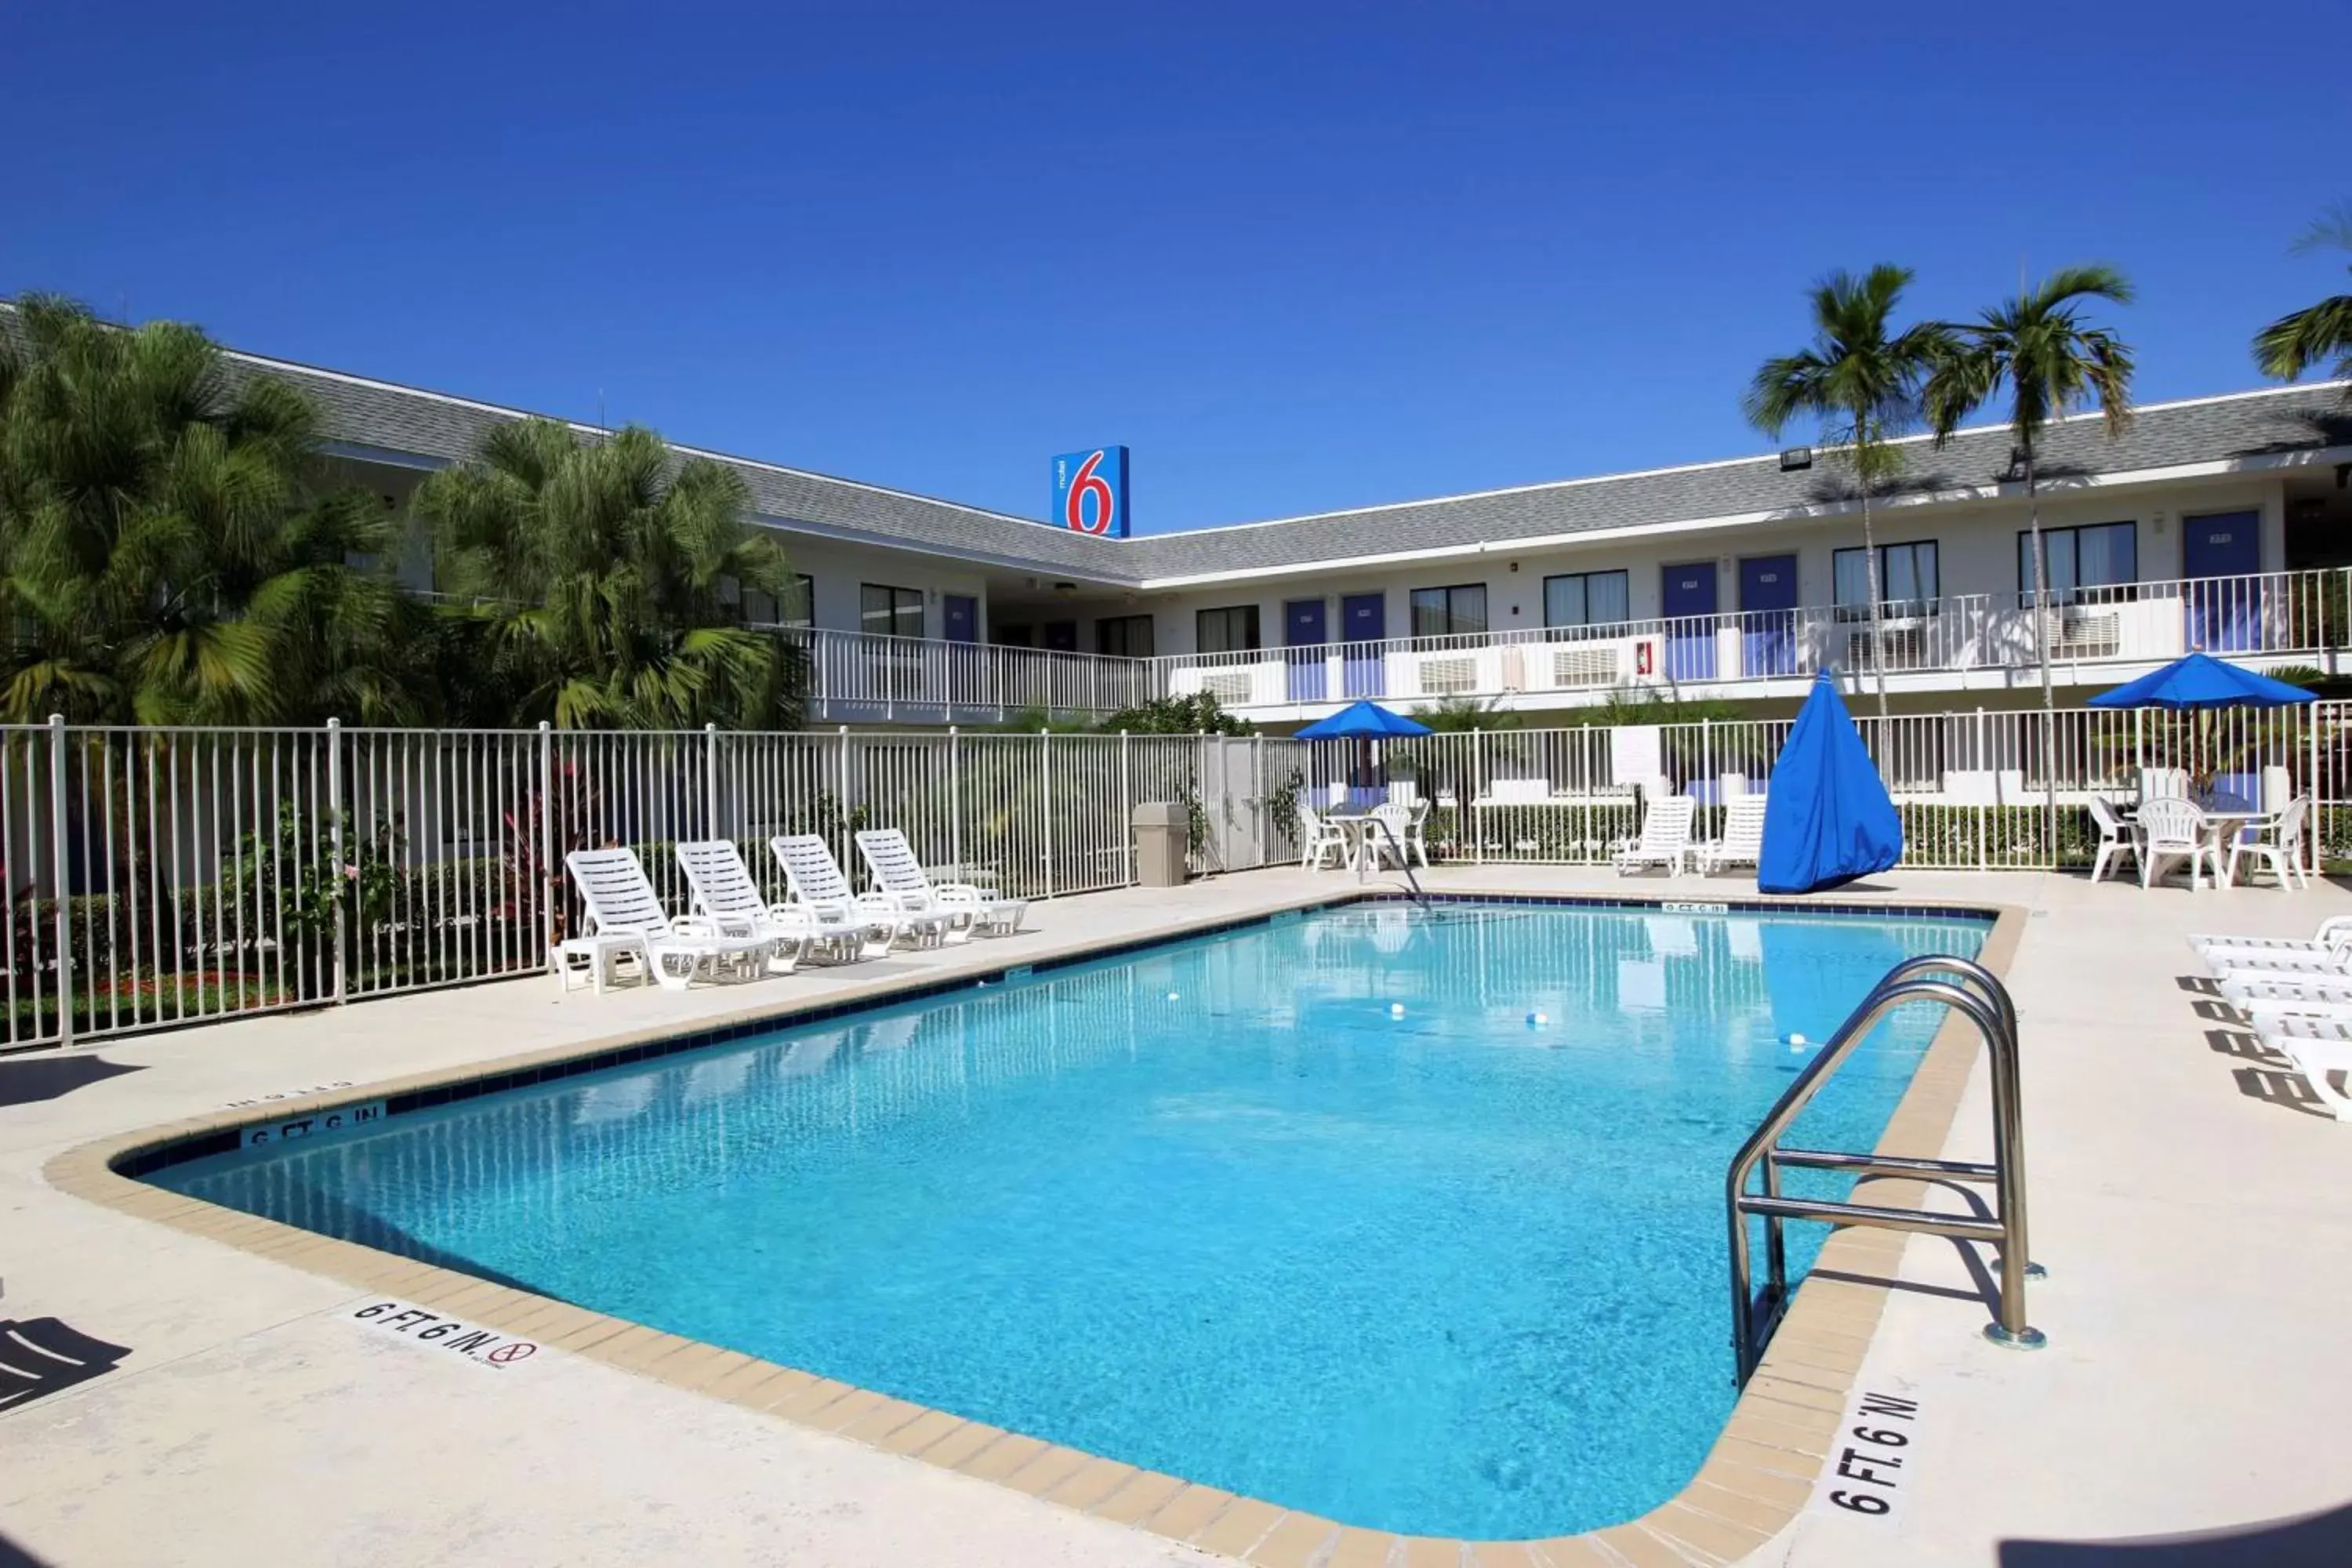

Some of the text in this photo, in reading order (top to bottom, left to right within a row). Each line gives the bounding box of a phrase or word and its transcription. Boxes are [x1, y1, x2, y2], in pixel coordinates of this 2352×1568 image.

[1065, 450, 1114, 535] 6
[354, 1302, 397, 1319] 6
[417, 1323, 461, 1340] 6
[1853, 1425, 1909, 1447] 6
[1829, 1490, 1891, 1515] 6
